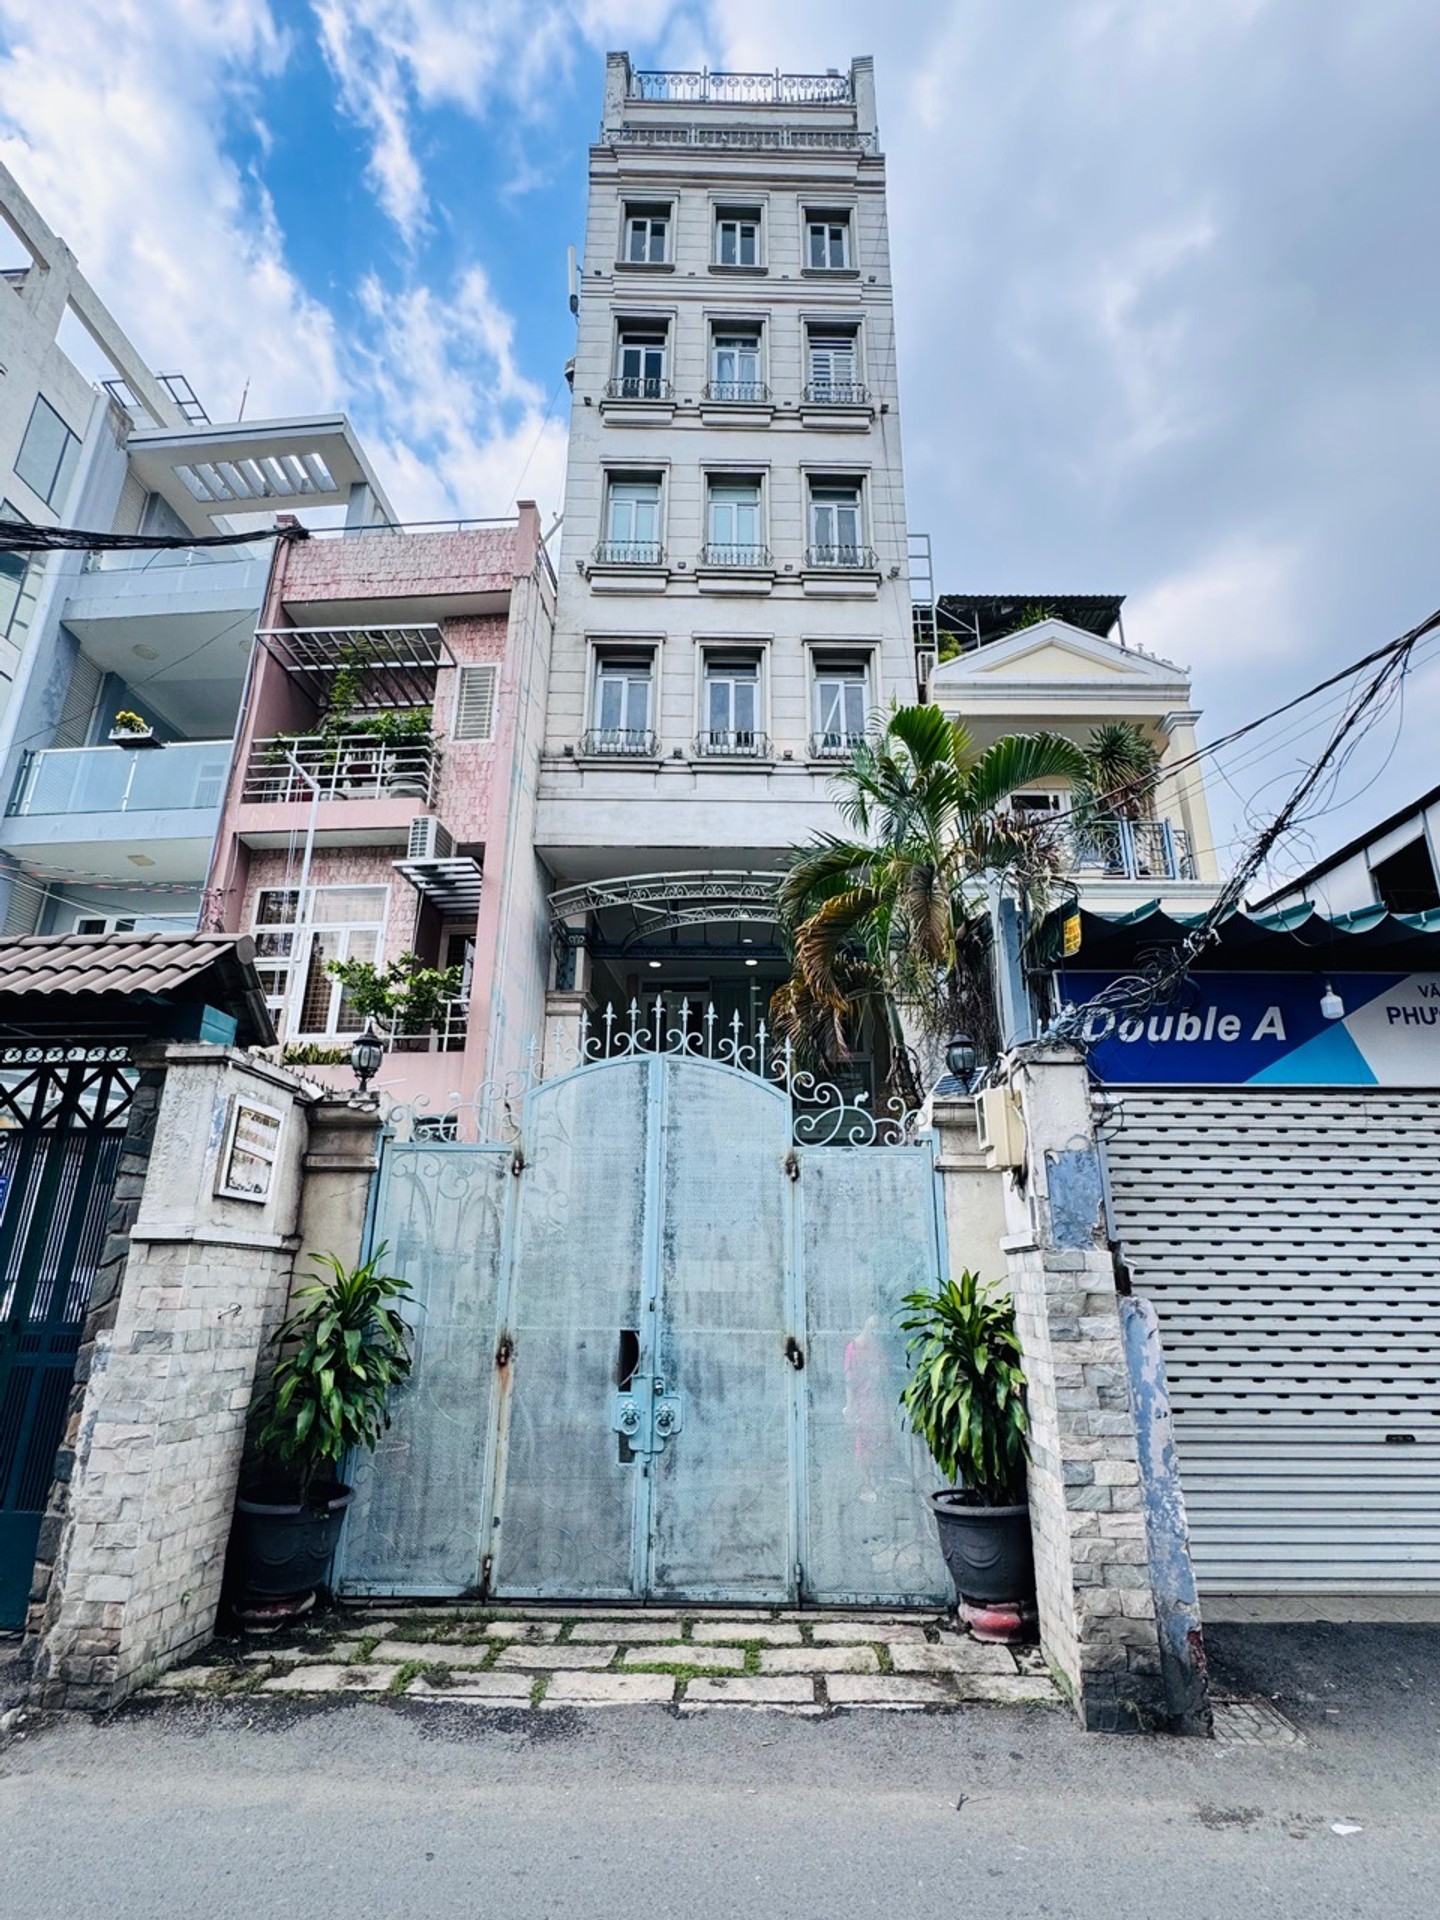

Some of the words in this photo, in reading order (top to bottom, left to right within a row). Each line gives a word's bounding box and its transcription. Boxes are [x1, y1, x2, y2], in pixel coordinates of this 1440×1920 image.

[1082, 1006, 1241, 1043] Double
[1250, 1006, 1287, 1041] A
[1386, 1006, 1440, 1026] PHƯ
